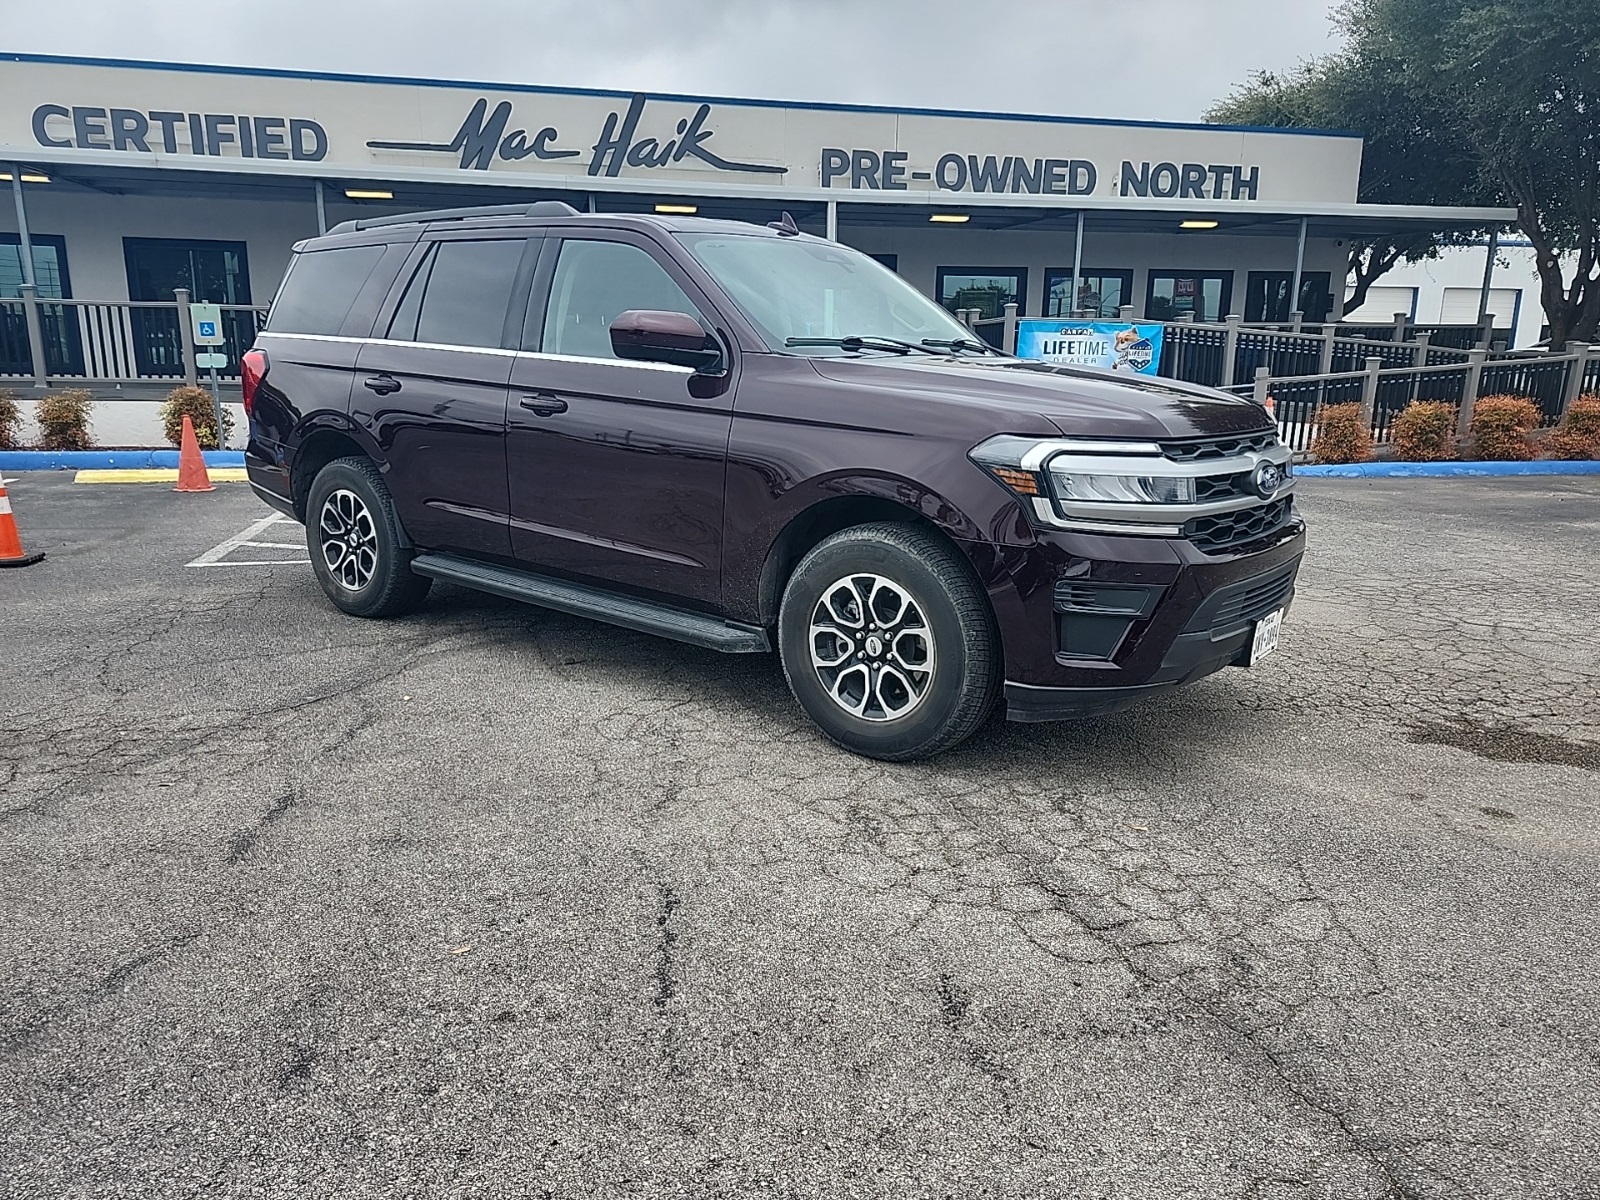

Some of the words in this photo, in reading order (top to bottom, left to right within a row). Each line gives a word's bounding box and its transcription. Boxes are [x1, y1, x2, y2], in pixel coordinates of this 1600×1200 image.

[32, 103, 328, 161] CERTIFIED
[366, 98, 580, 170] Mac
[587, 93, 788, 178] Haik
[820, 148, 1097, 195] PRE-OWNED
[1119, 161, 1259, 200] NORTH
[1043, 340, 1108, 355] LIFETIME
[1060, 328, 1094, 336] CARFAX
